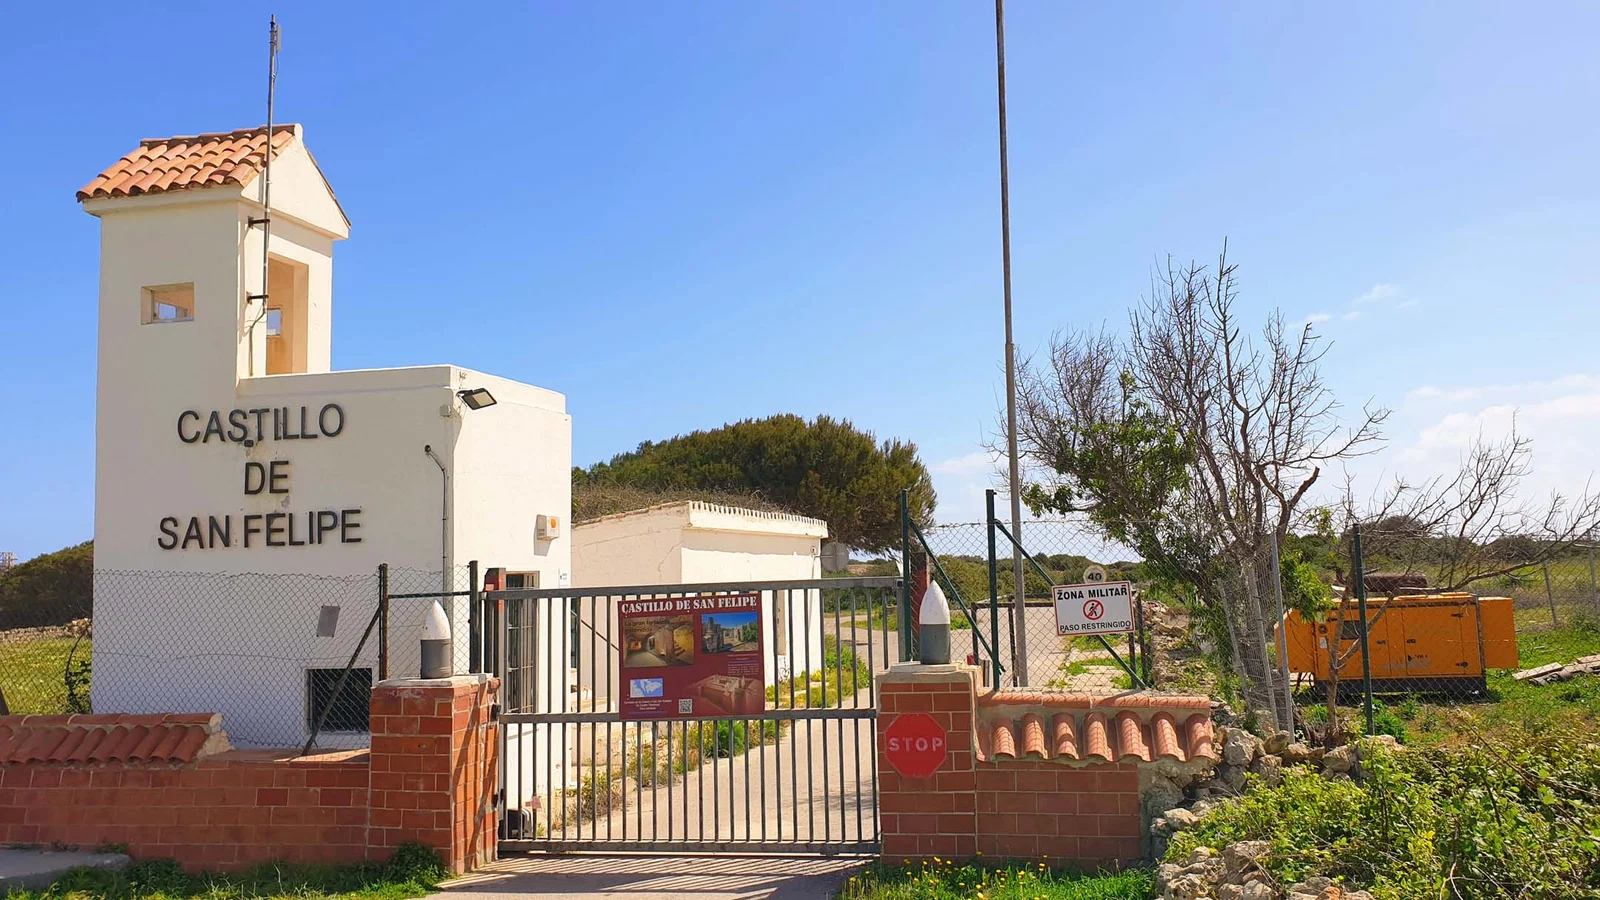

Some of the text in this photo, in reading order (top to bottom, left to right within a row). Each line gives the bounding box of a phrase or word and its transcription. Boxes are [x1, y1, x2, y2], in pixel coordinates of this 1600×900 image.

[177, 403, 345, 444] CASTILLO
[244, 460, 290, 495] DE
[157, 509, 362, 551] SAN FELIPE
[1088, 572, 1102, 581] 40
[1057, 587, 1128, 600] ZONA MILITAR
[621, 596, 757, 613] CASTILLO DE SAN FELIPE
[1060, 620, 1131, 631] PASO RESTRINGIDO
[888, 737, 943, 752] STOP
